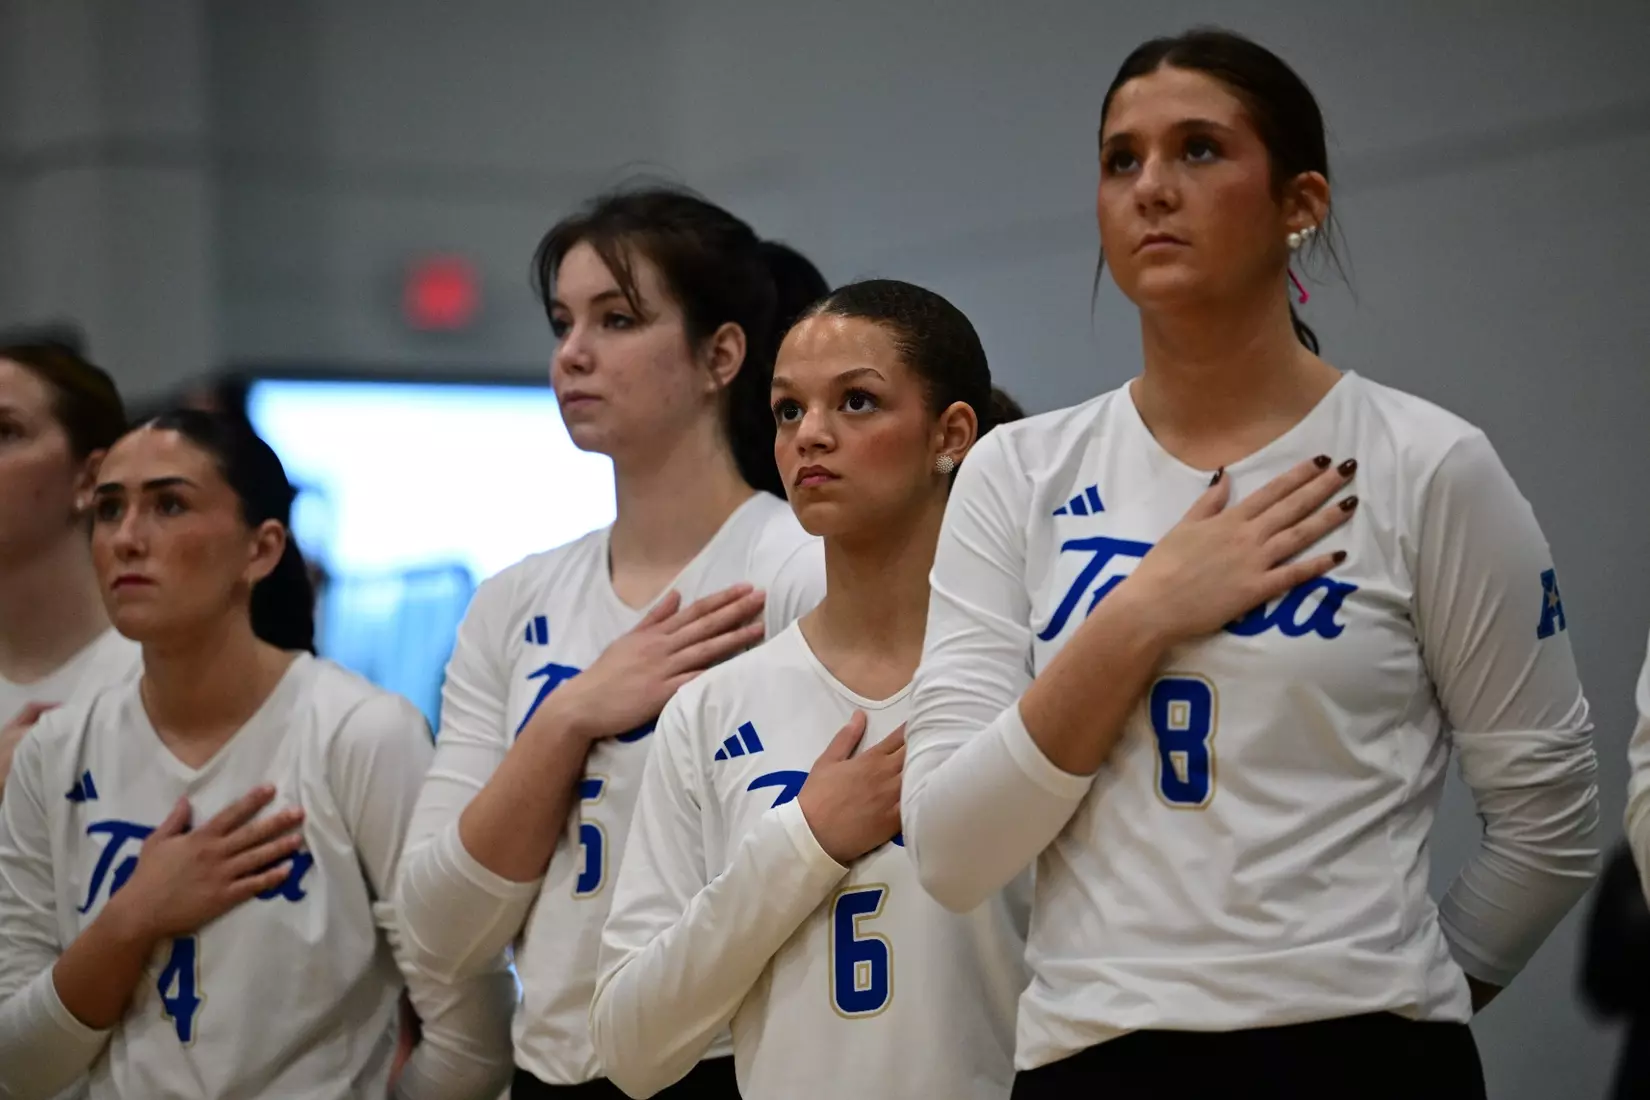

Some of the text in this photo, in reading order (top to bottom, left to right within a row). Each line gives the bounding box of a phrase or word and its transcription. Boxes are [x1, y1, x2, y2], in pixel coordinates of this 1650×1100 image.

[1537, 568, 1566, 640] A
[1149, 673, 1217, 809] 8
[157, 935, 206, 1047] 4
[829, 884, 893, 1018] 6
